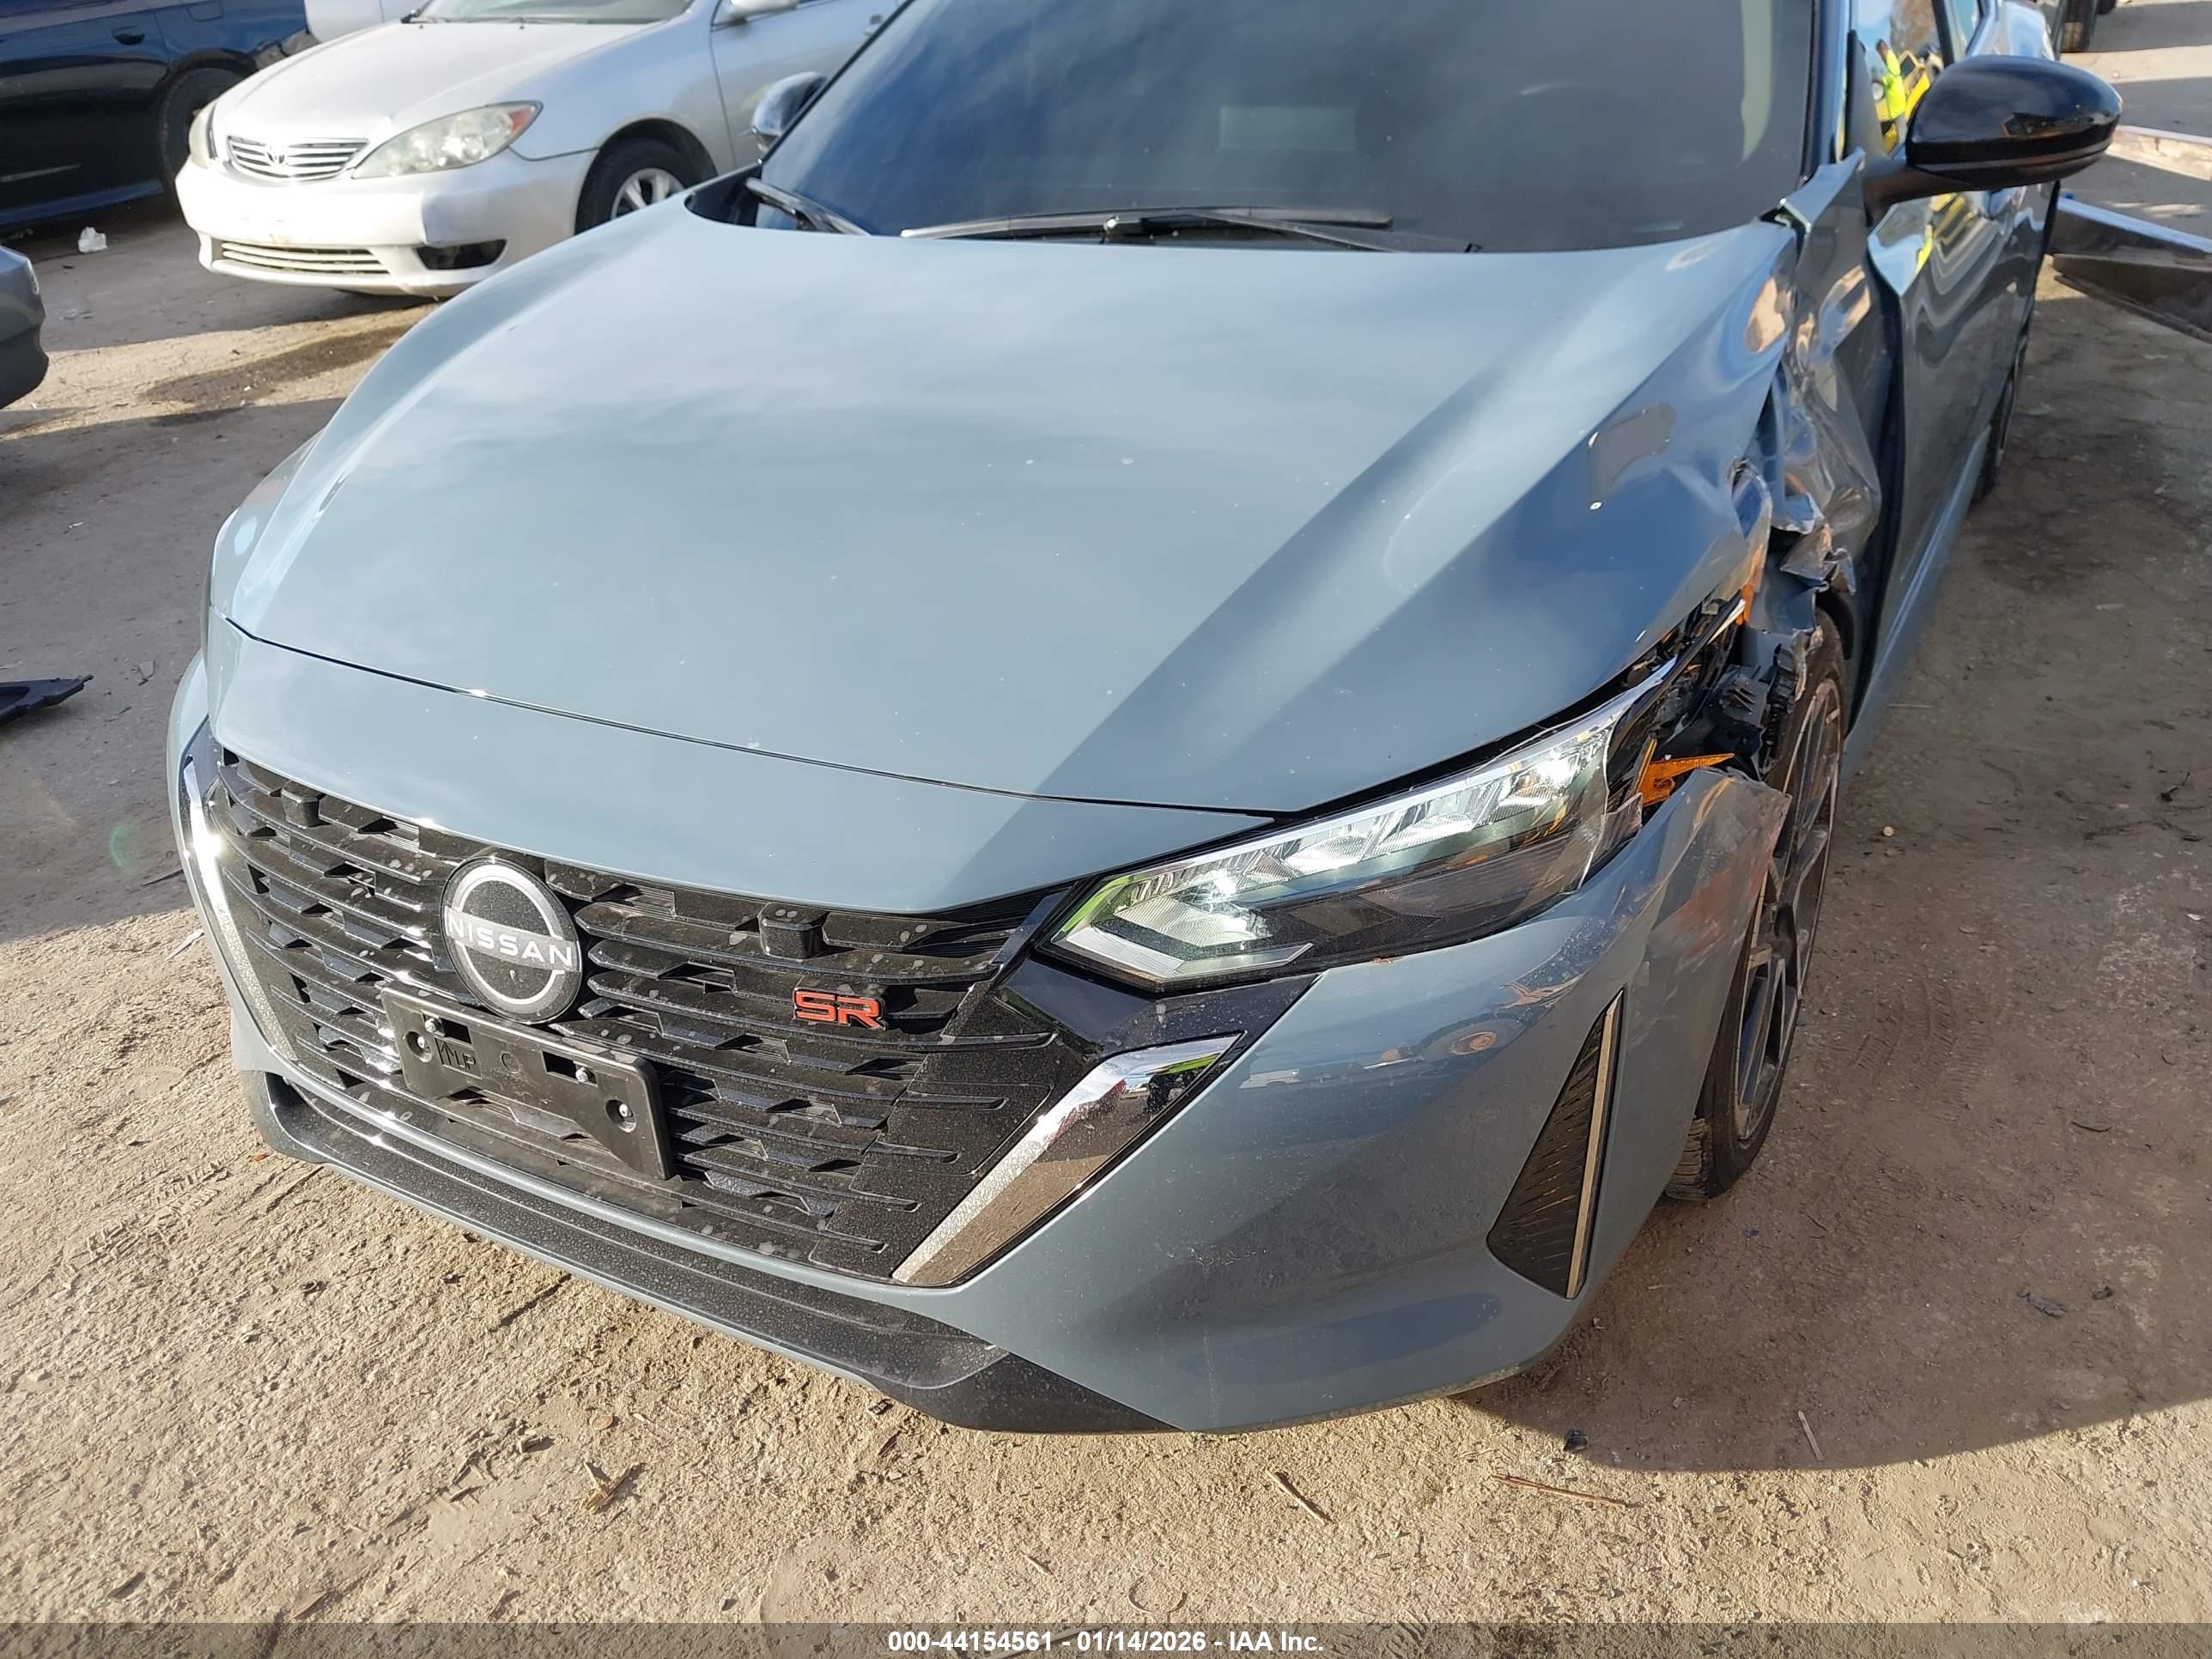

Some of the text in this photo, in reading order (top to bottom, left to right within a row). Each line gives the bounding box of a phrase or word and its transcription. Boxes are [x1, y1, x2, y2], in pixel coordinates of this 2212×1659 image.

[447, 915, 573, 967] NISSAN
[793, 988, 886, 1030] SR
[452, 1049, 477, 1072] UP
